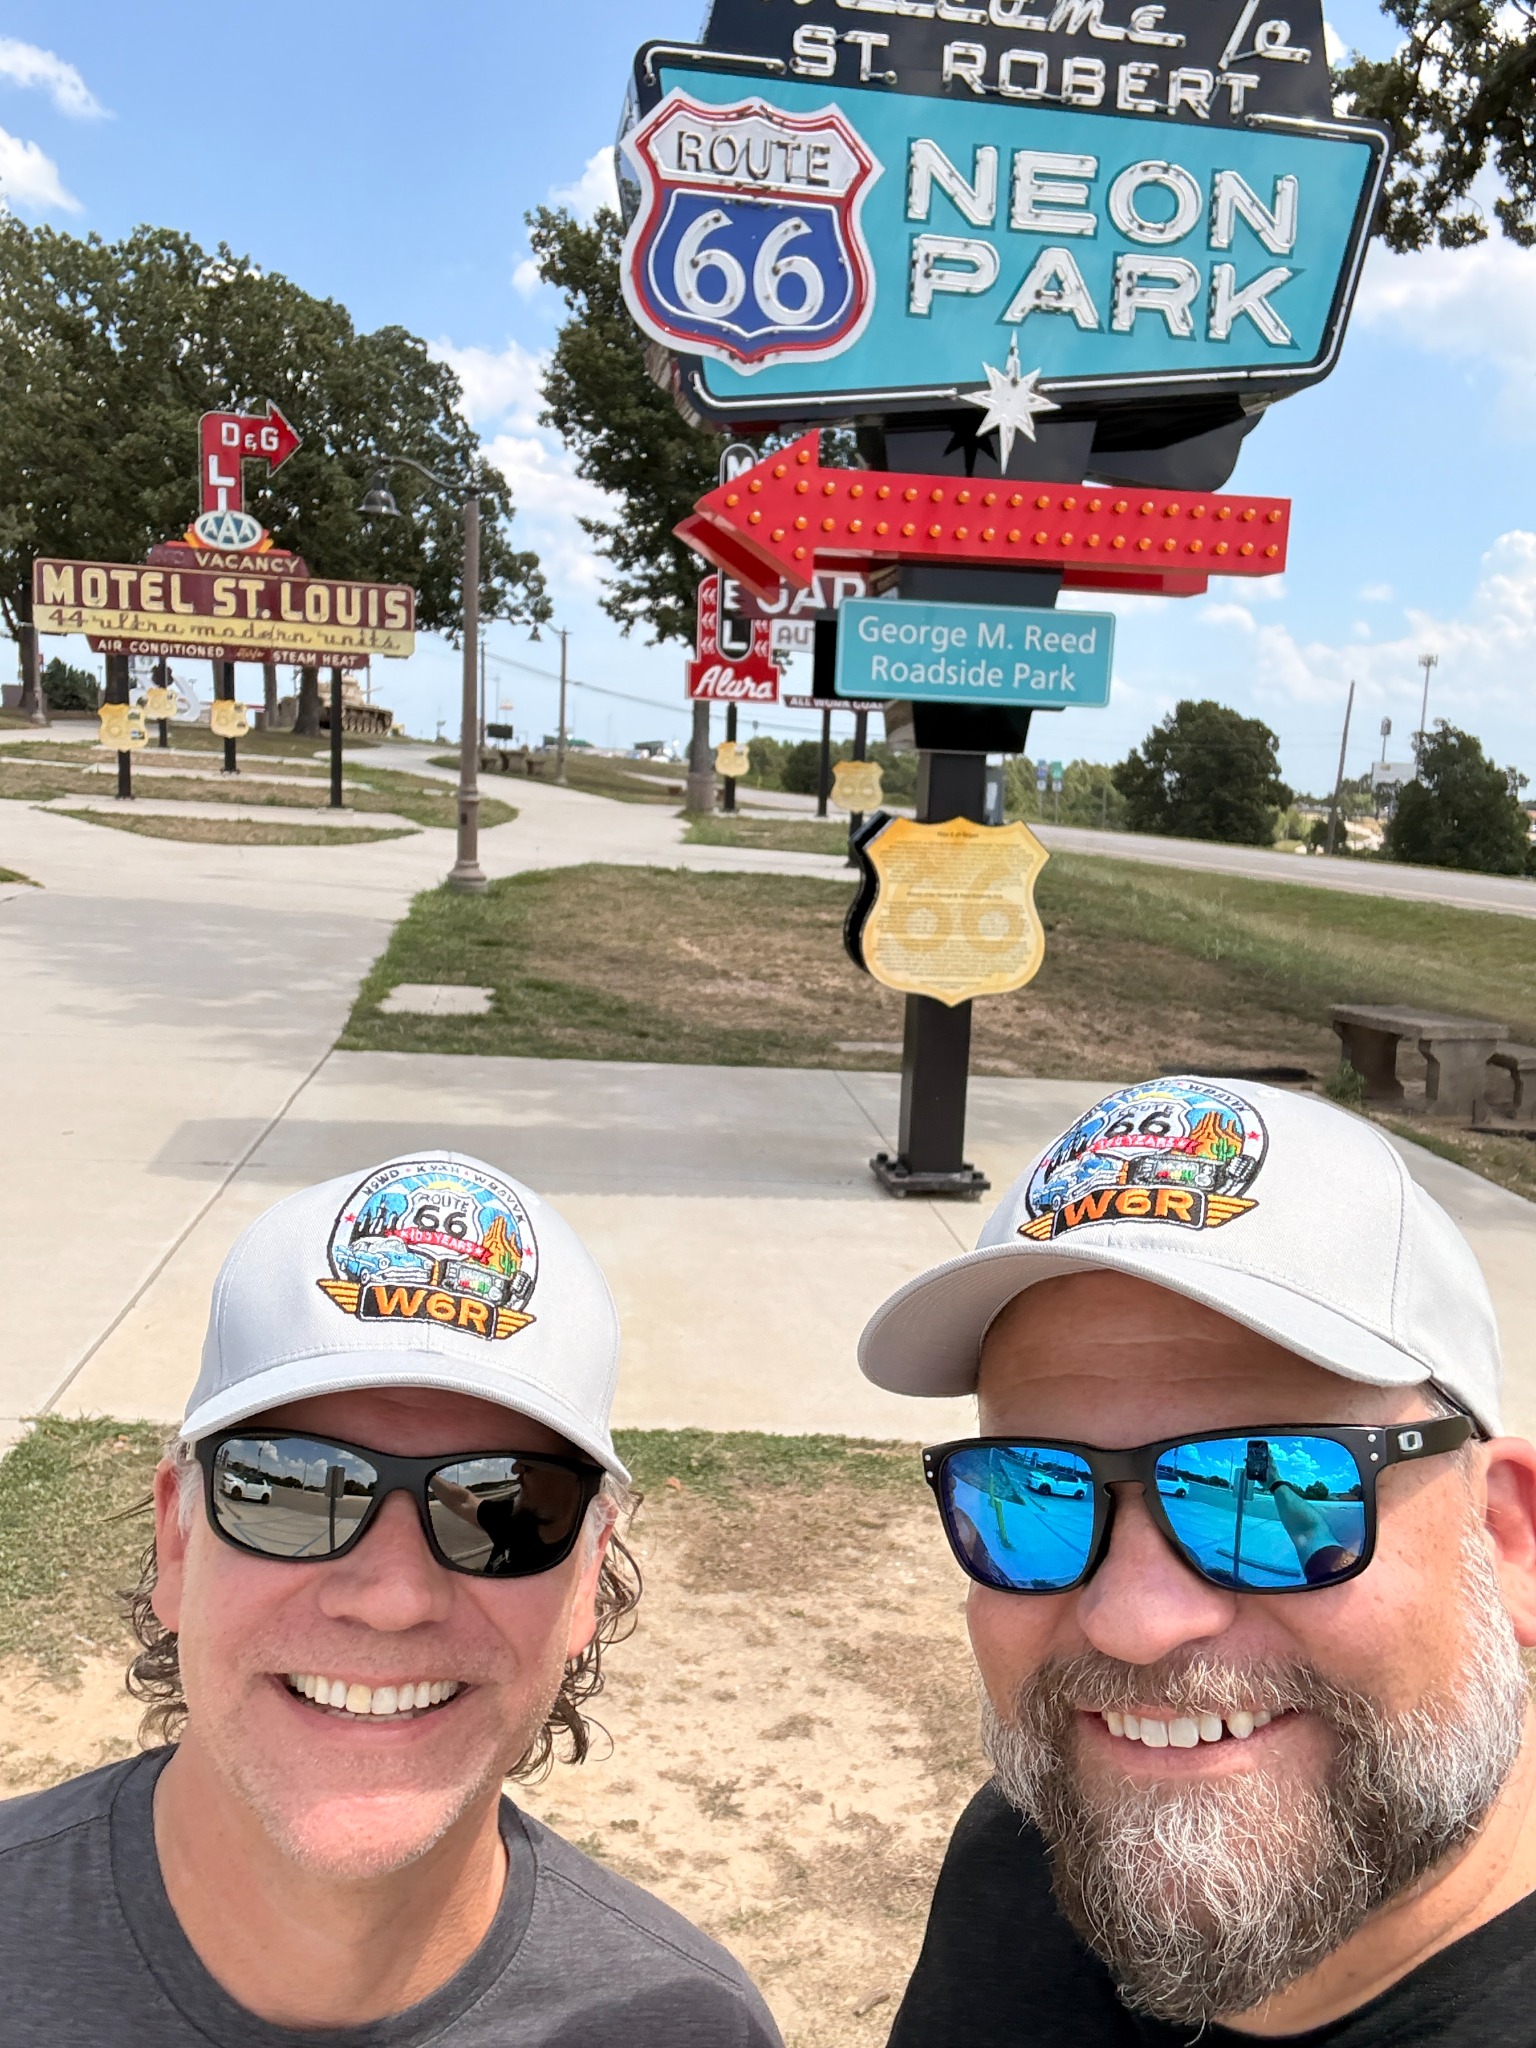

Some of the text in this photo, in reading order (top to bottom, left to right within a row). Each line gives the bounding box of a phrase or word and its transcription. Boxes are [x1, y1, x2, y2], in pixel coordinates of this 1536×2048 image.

[942, 41, 1261, 120] ROBERT
[676, 129, 833, 186] ROUTE
[906, 137, 1299, 254] NEON
[673, 208, 825, 326] 66
[907, 234, 1296, 346] PARK
[202, 512, 255, 544] AAA
[194, 551, 300, 574] VACANCY
[42, 564, 194, 614] MOTEL
[48, 607, 88, 628] 44
[96, 609, 186, 636] ultra
[190, 622, 313, 645] modern
[857, 614, 1097, 655] George M. Reed
[97, 639, 123, 651] AIR
[129, 641, 225, 657] CONDITIONED
[272, 650, 317, 666] STEAM
[321, 653, 359, 667] HEAT
[692, 665, 774, 698] Alura
[870, 655, 1076, 692] Roadside Park
[1103, 1111, 1171, 1140] 66
[1118, 1102, 1175, 1118] ROUTE
[1127, 1135, 1174, 1148] YEARS
[412, 1204, 468, 1239] 66
[418, 1193, 469, 1213] ROUTE
[1063, 1188, 1195, 1227] W6R
[434, 1232, 473, 1255] YEARS
[372, 1285, 490, 1334] W6R
